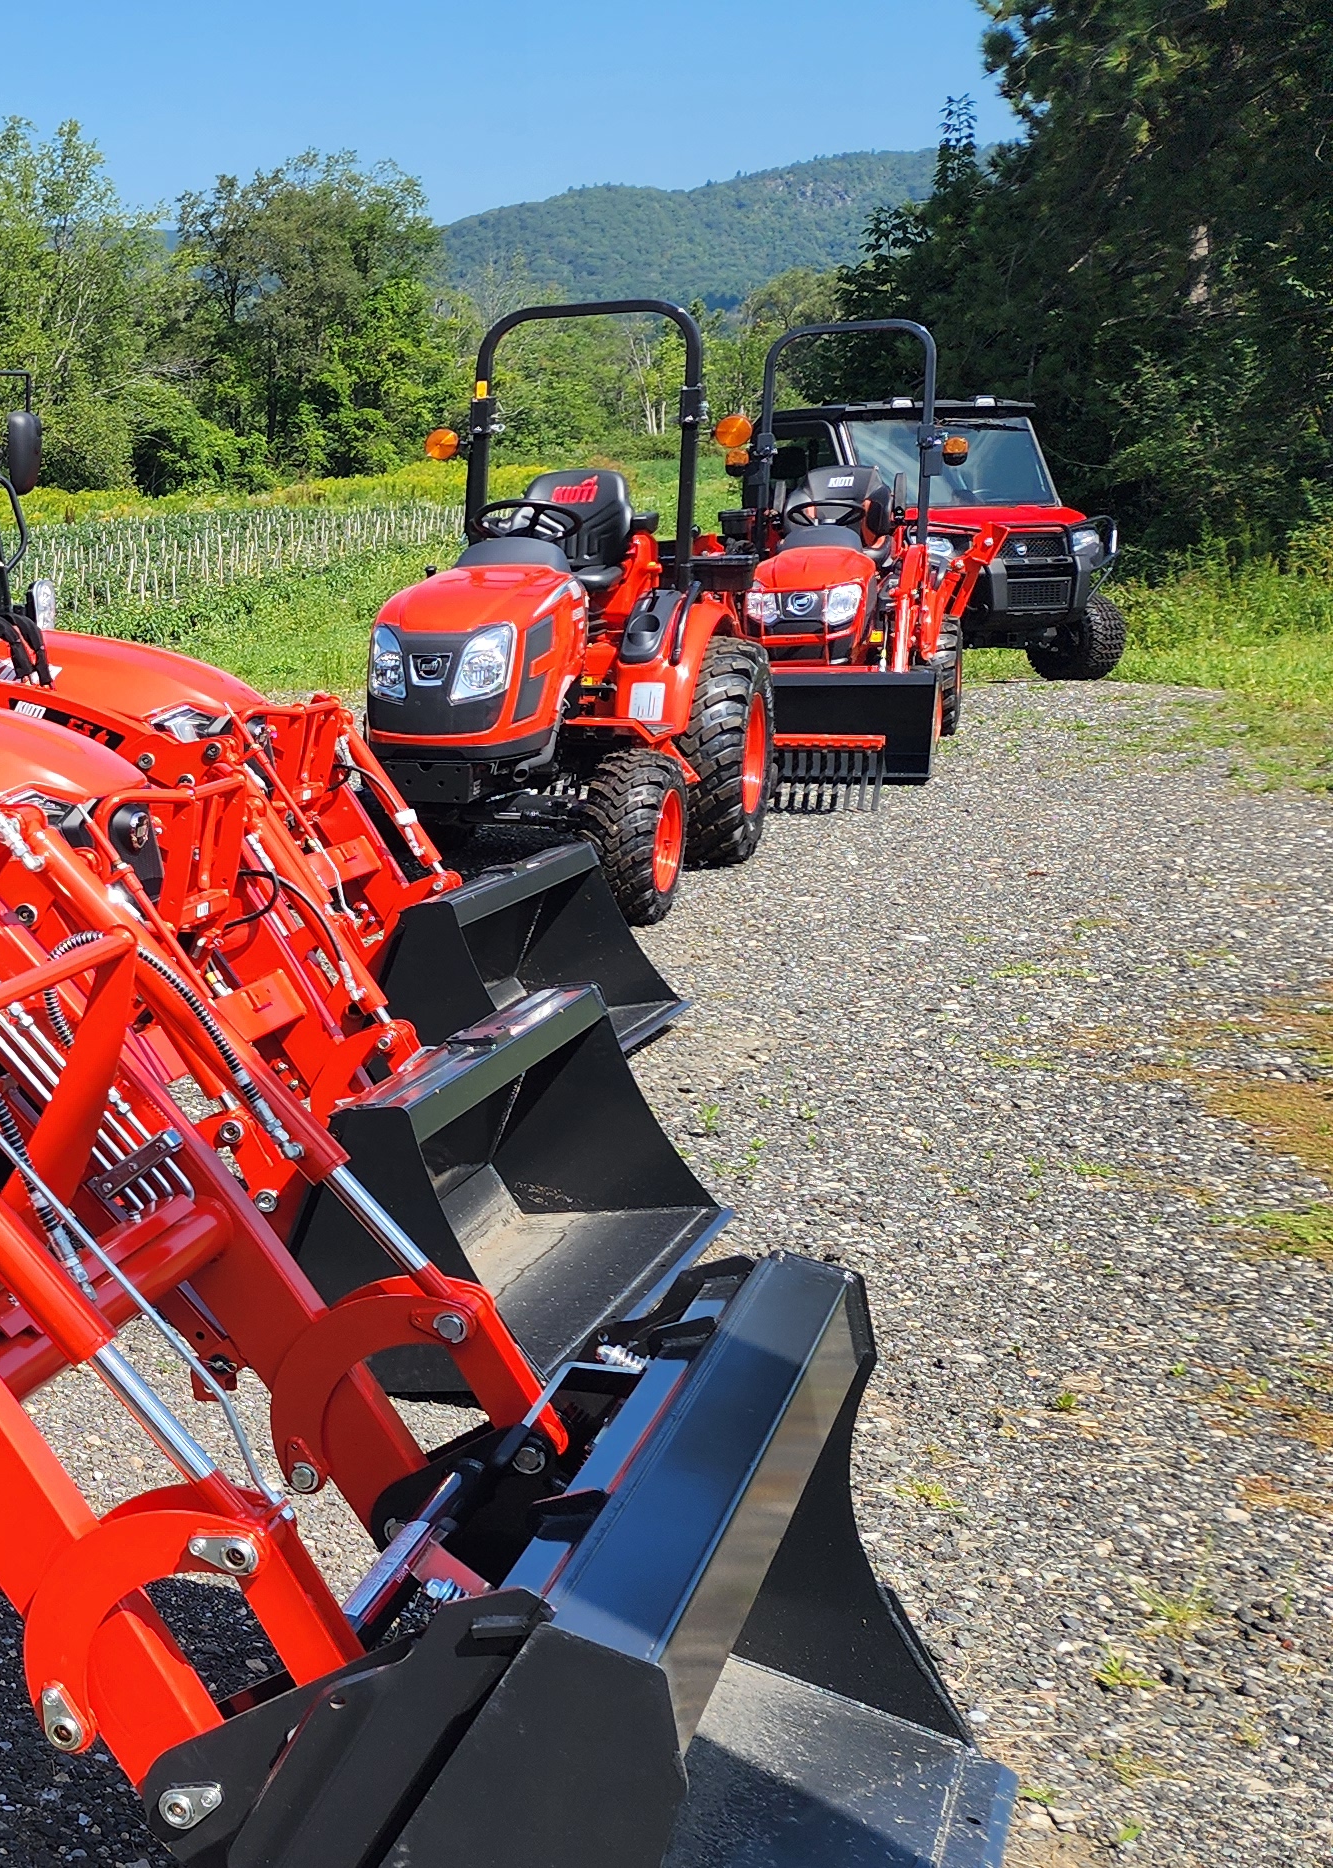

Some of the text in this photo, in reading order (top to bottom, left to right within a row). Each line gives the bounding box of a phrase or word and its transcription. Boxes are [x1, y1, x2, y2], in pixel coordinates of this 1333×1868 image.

[827, 476, 855, 488] KIOTI
[551, 484, 598, 504] KIOTI
[13, 700, 47, 720] KIOTI
